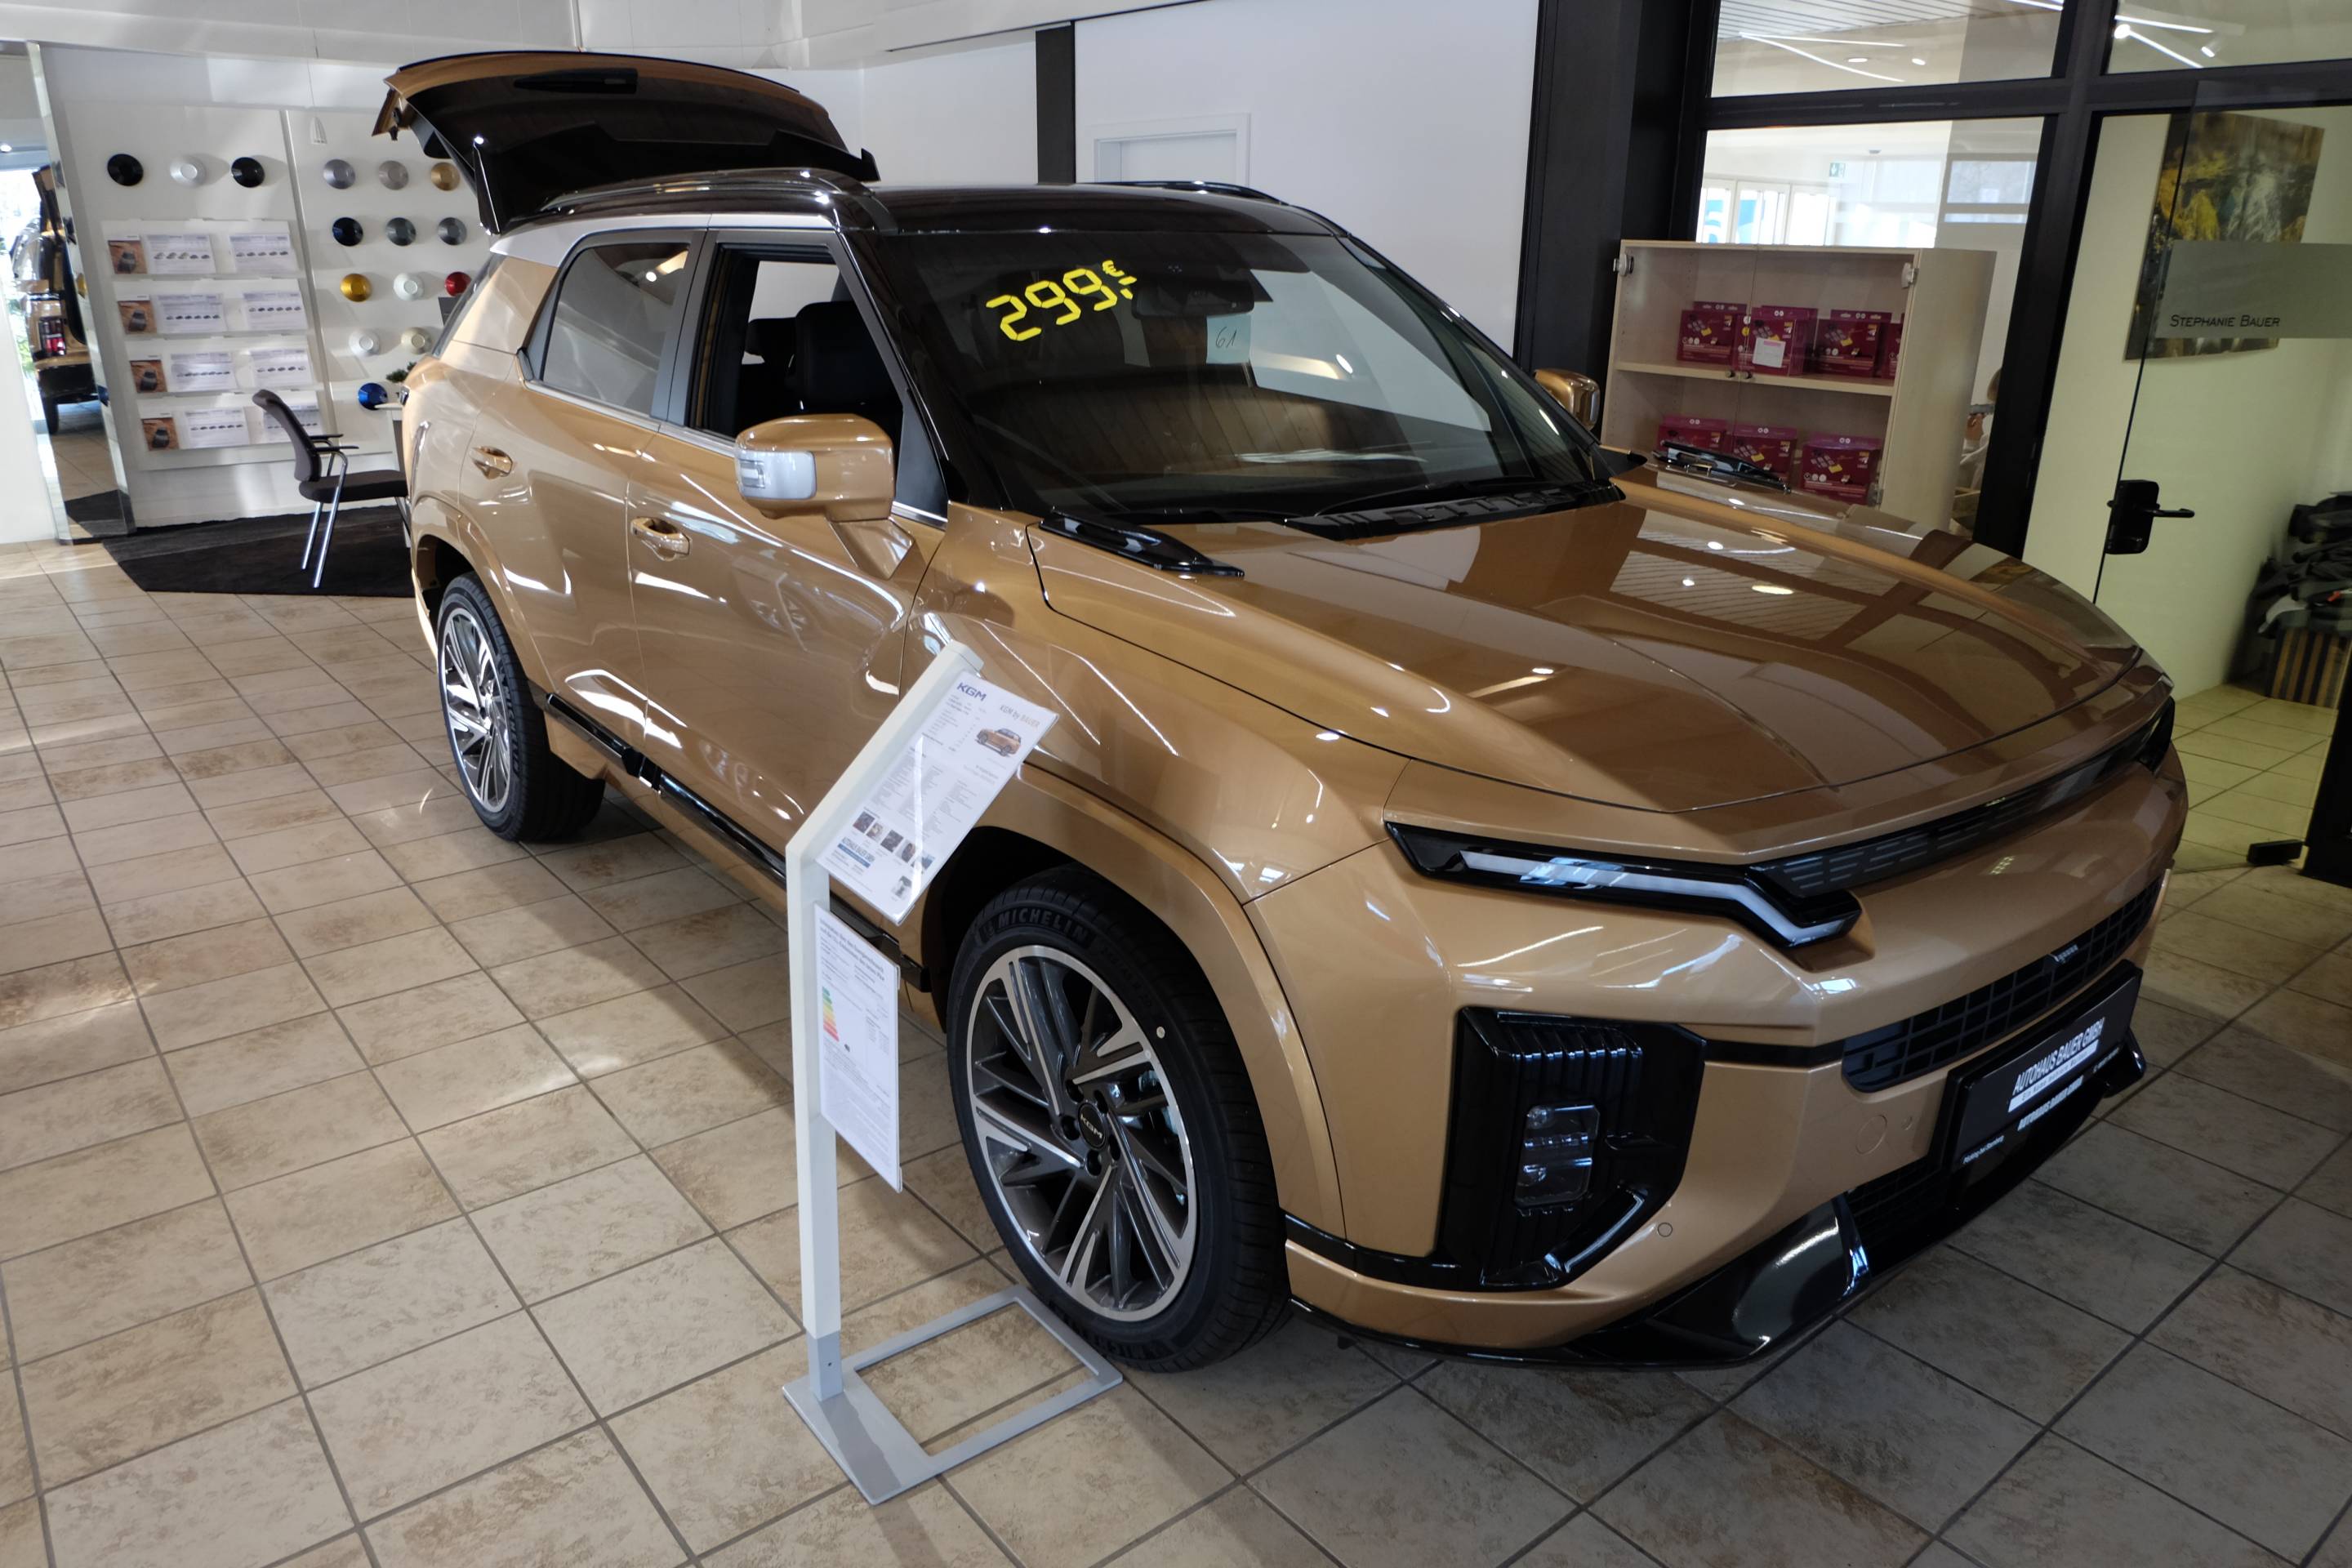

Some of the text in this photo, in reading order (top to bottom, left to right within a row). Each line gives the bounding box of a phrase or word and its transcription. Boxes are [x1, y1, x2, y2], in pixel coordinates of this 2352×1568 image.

[2240, 315, 2281, 327] BAUER
[1215, 326, 1237, 349] 61
[956, 682, 987, 702] KGM
[1000, 704, 1013, 715] KGM
[998, 908, 1089, 942] MICHELIN
[2012, 1049, 2058, 1096] AUTOHAUS
[2056, 1032, 2083, 1066] BAUER
